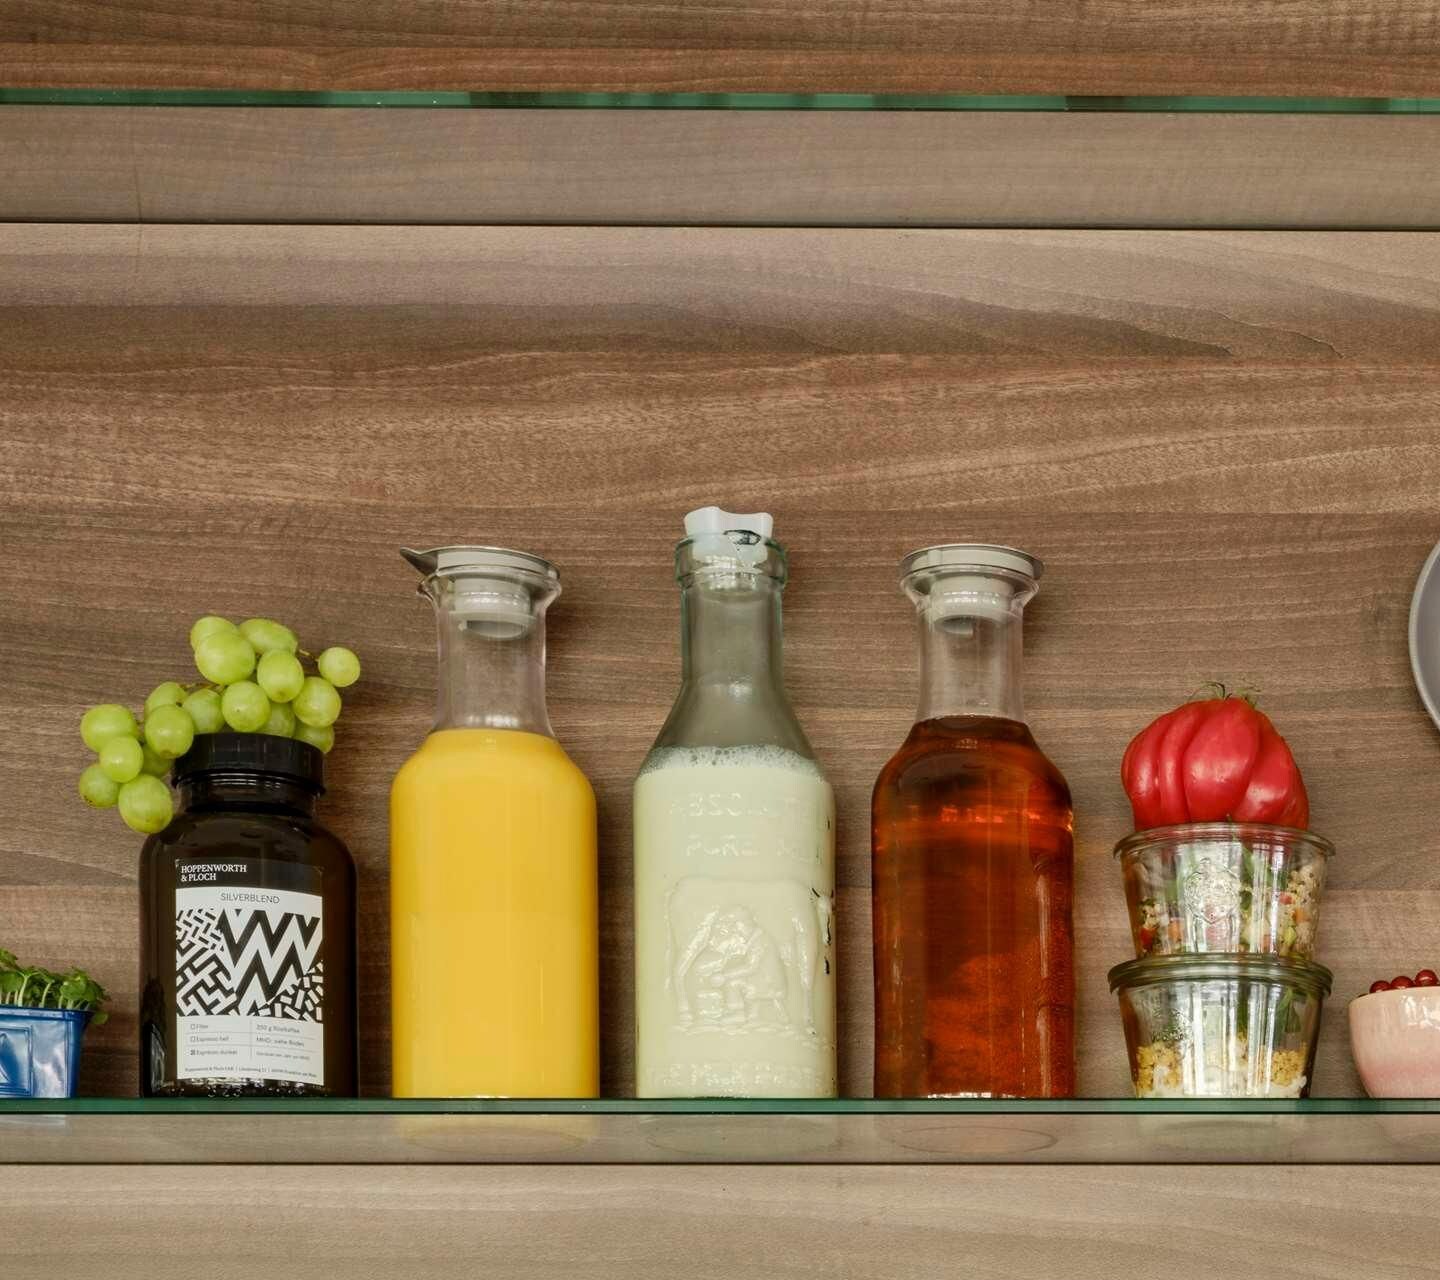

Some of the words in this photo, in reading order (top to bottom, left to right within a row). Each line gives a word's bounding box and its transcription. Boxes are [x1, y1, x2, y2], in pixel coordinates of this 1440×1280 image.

[180, 863, 247, 874] HOPPENWORTH
[188, 872, 216, 882] PLOCH
[220, 893, 280, 904] SILVERBLEND
